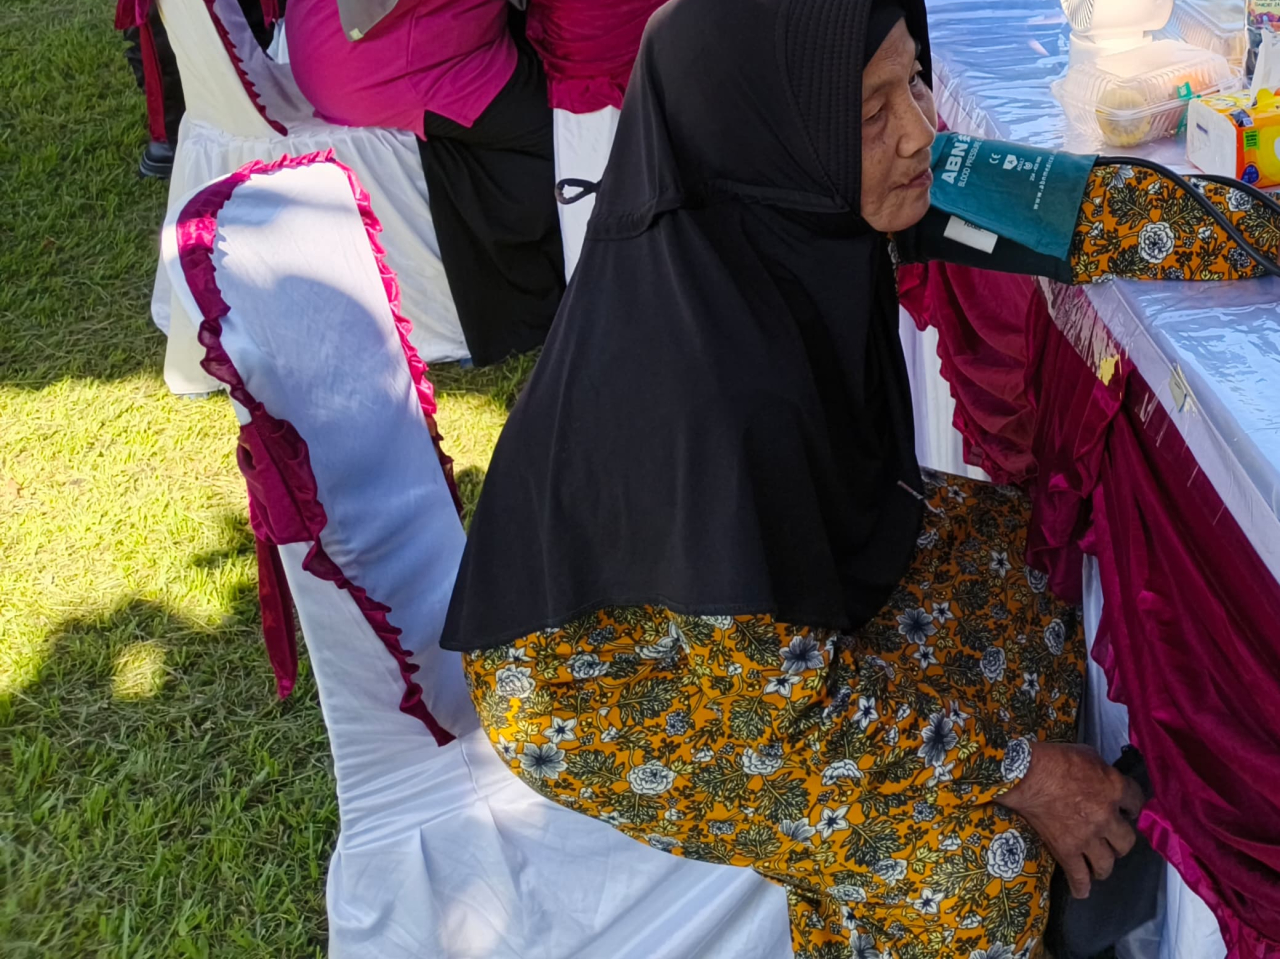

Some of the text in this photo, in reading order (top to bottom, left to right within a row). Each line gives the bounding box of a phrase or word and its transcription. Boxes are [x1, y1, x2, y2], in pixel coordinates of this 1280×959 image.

[941, 143, 966, 184] ABN
[958, 139, 982, 188] BLOOD PRESSURE
